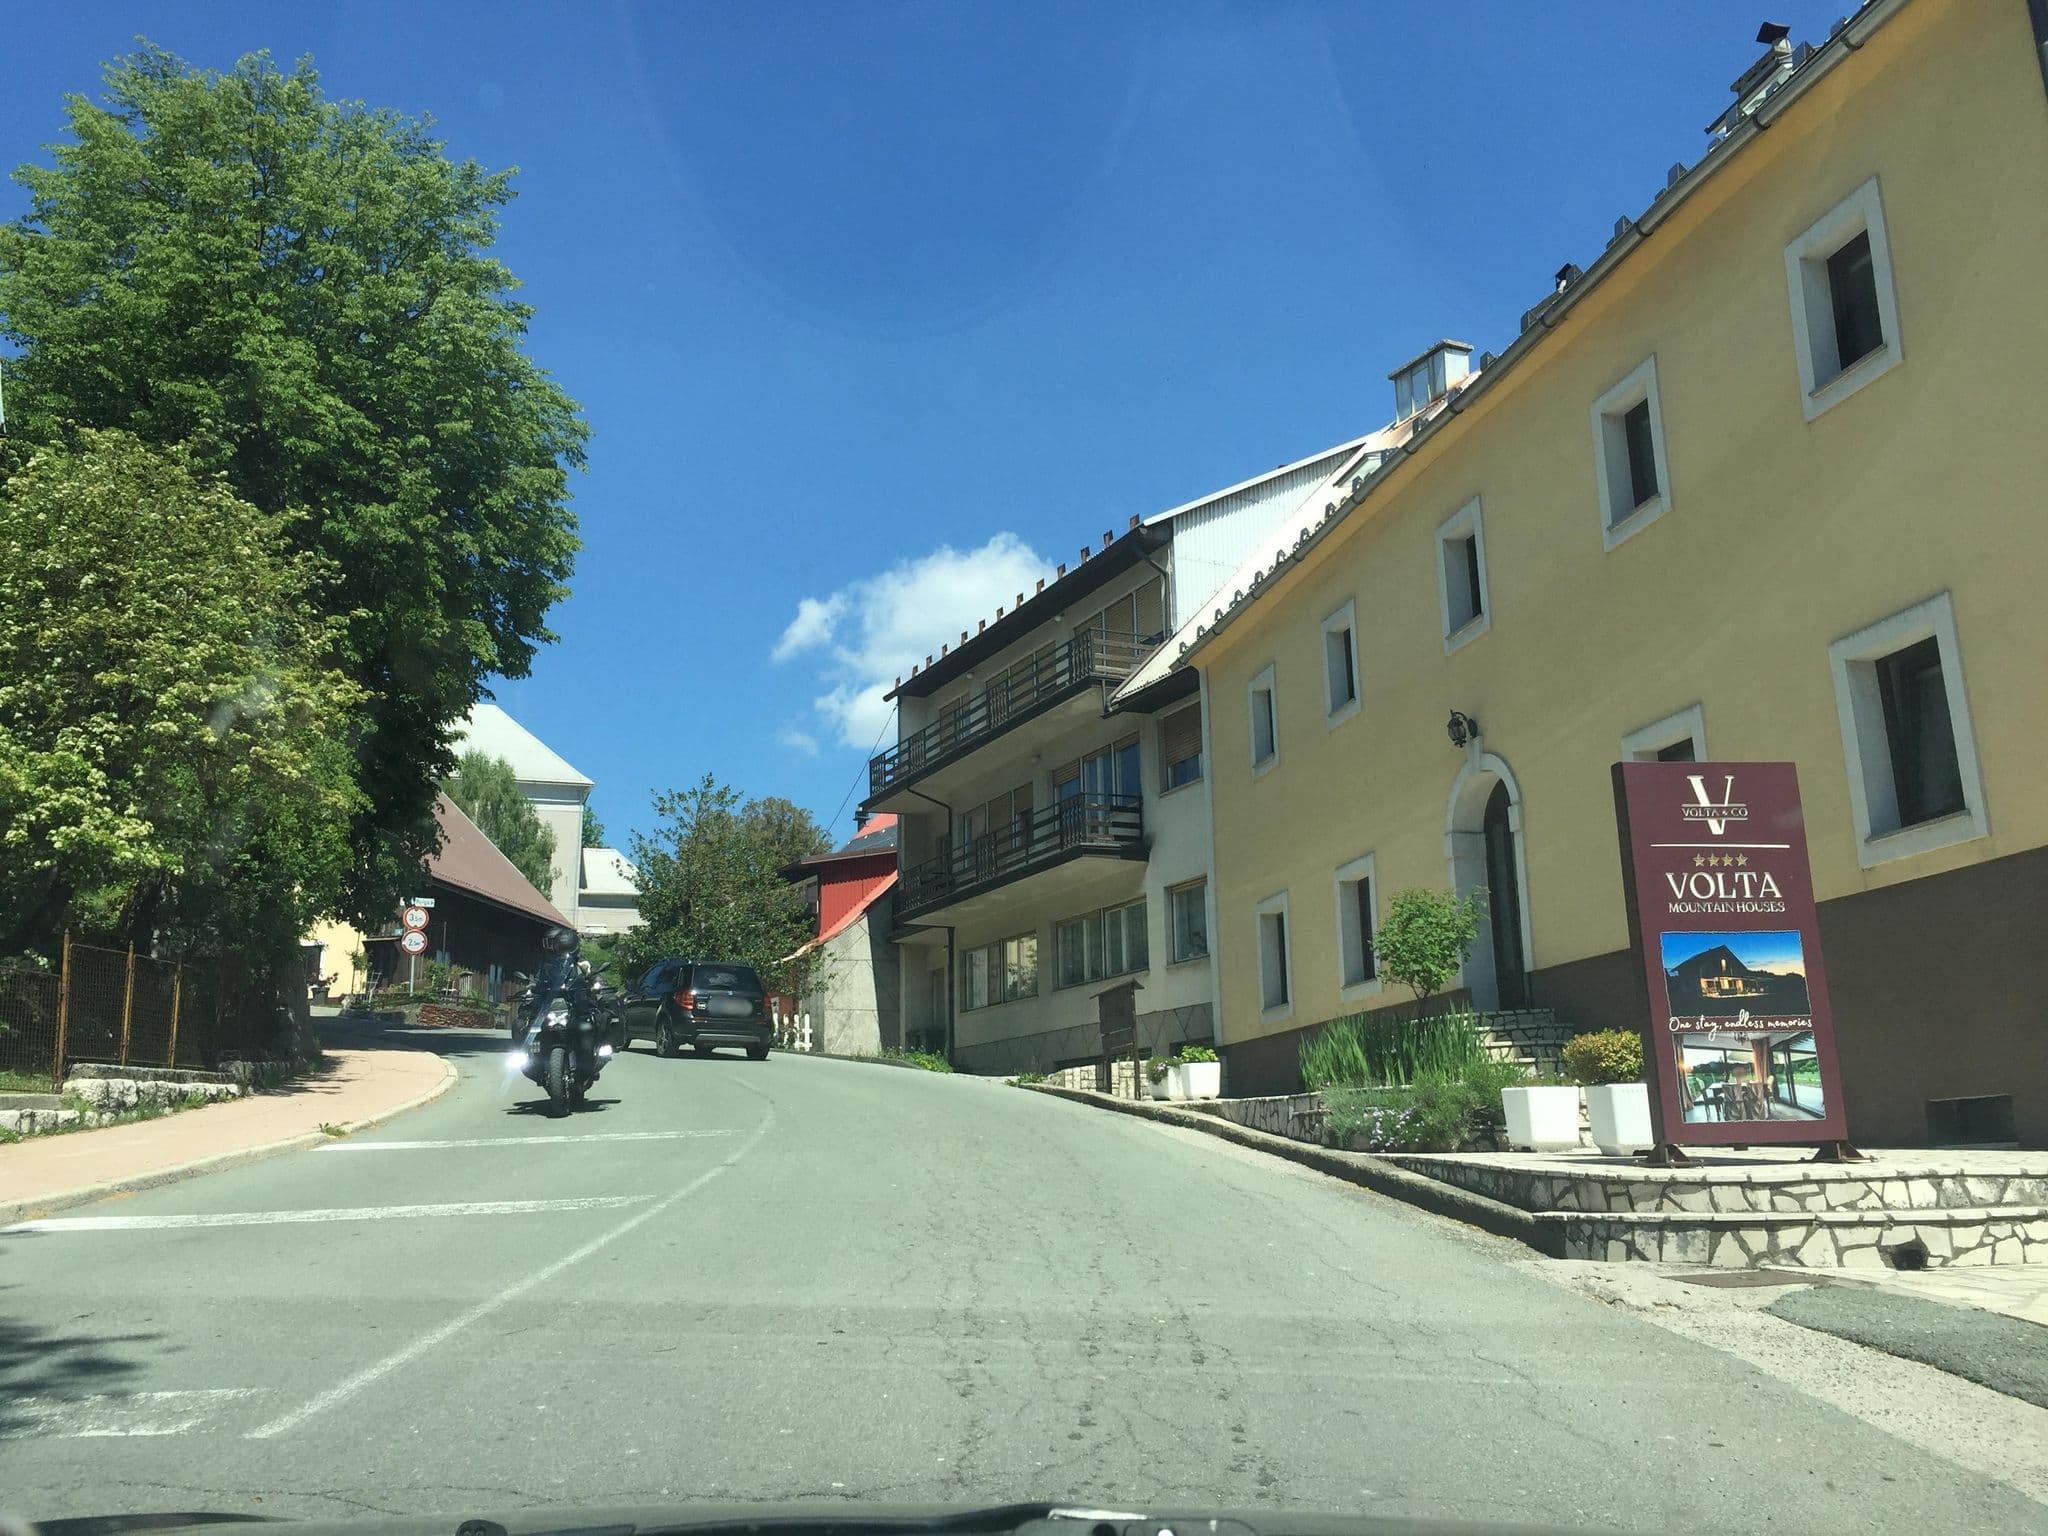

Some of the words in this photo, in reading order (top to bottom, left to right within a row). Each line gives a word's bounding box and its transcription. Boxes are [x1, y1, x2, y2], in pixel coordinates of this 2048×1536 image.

[1681, 807, 1719, 817] VOLTA
[1730, 807, 1749, 817] CO
[1665, 871, 1782, 899] VOLTA
[1668, 902, 1734, 913] MOUNTAIN
[1736, 901, 1786, 913] HOUSES
[1668, 1016, 1691, 1028] One
[1695, 1013, 1722, 1042] stay,
[1724, 1008, 1764, 1028] endless
[1767, 1016, 1813, 1028] memories
